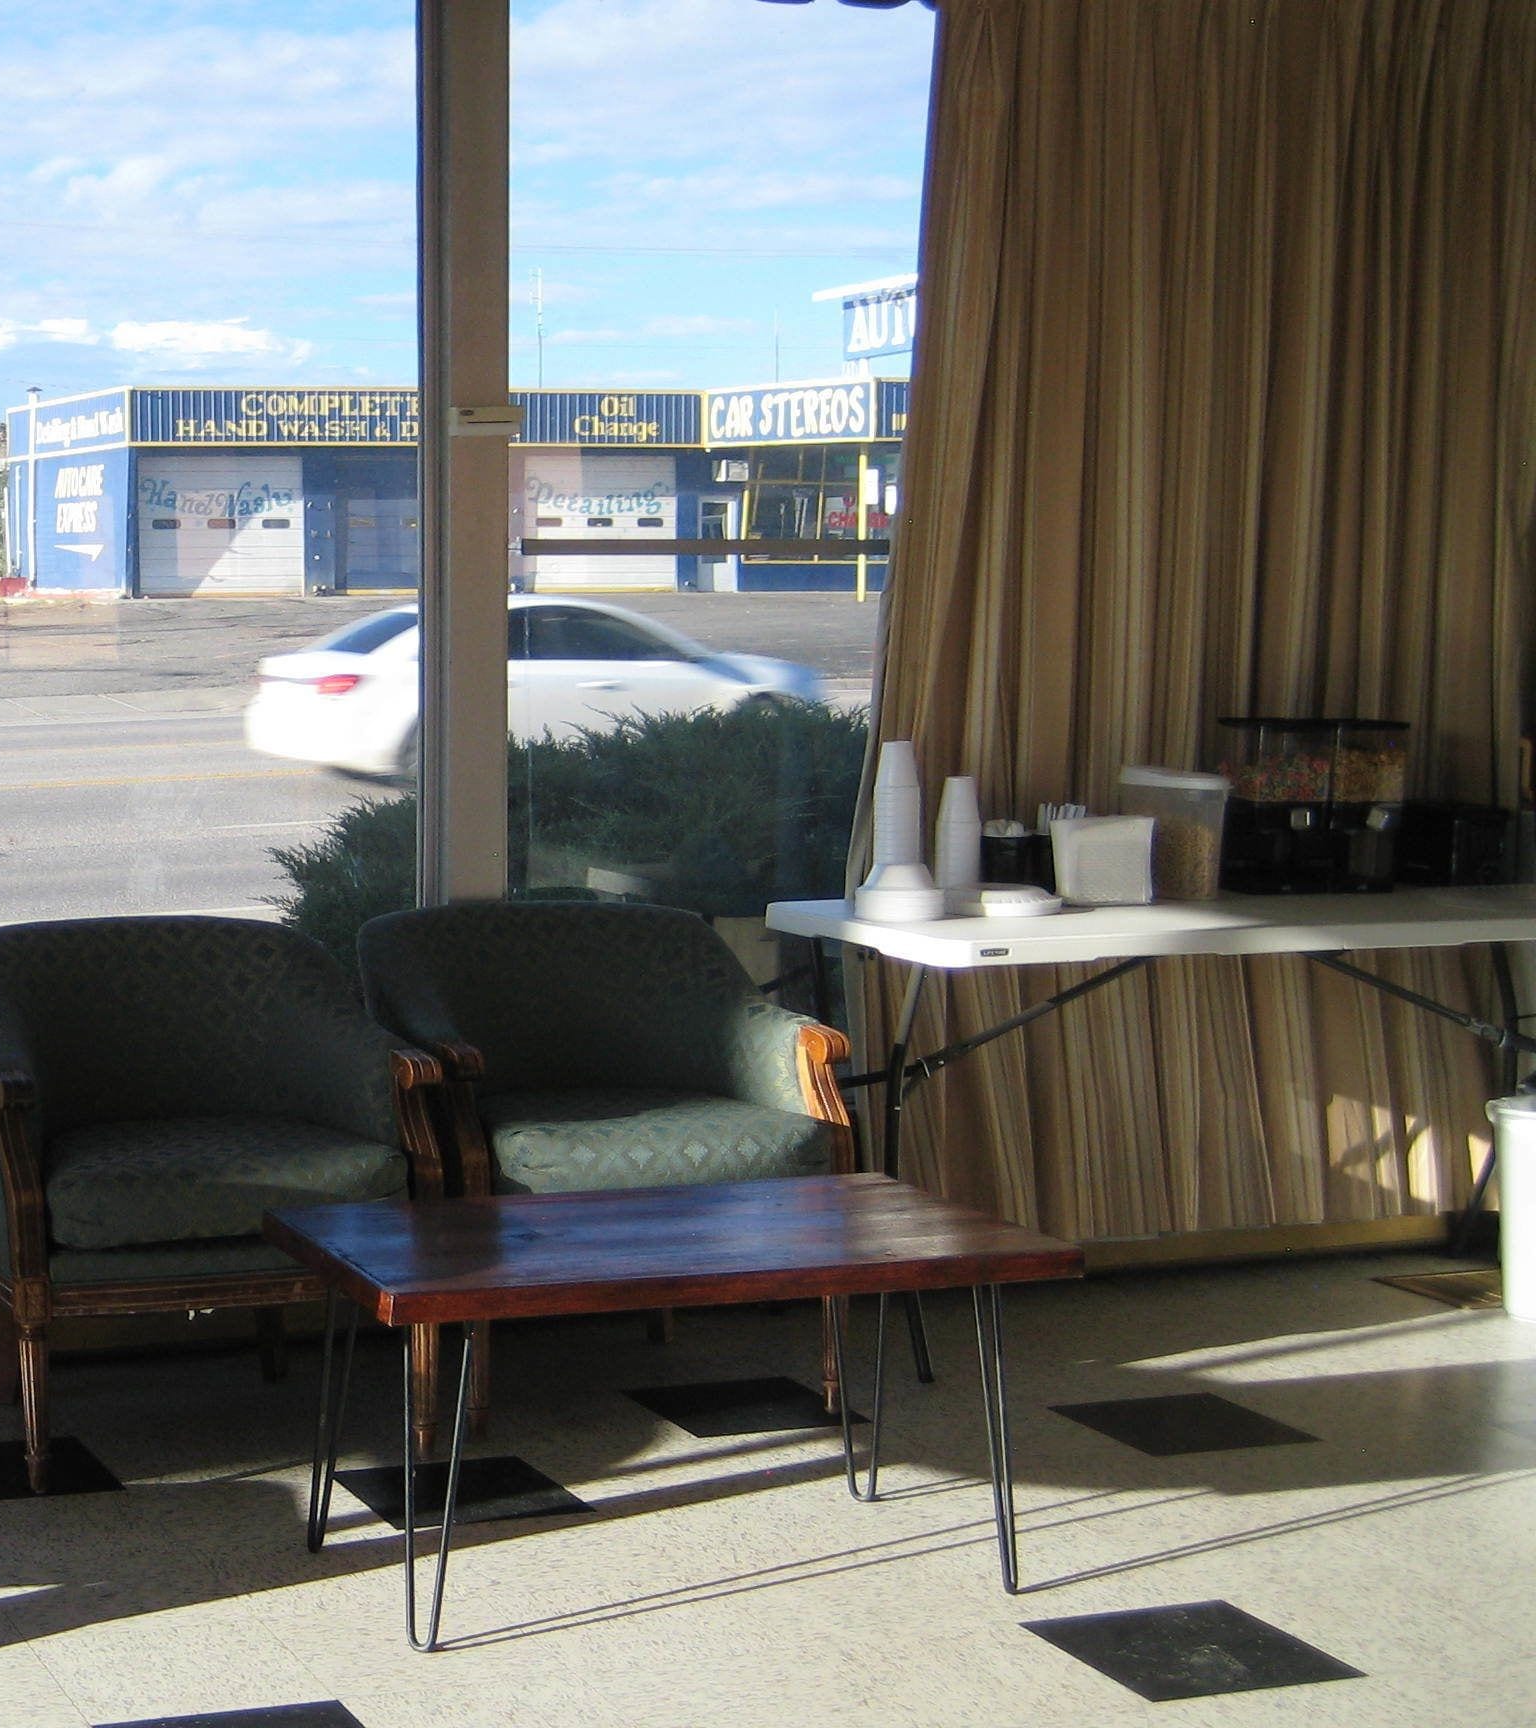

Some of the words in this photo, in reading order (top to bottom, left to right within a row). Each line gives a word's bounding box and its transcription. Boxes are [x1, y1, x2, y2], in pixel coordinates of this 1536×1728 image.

[600, 396, 637, 417] Oil
[710, 395, 754, 439] CAR
[759, 385, 865, 437] STEREOS
[175, 419, 268, 437] HAND
[278, 419, 369, 437] WASH
[375, 421, 392, 437] &
[574, 415, 660, 442] Change
[525, 475, 665, 516] Detailing
[56, 500, 98, 534] EXPRESS
